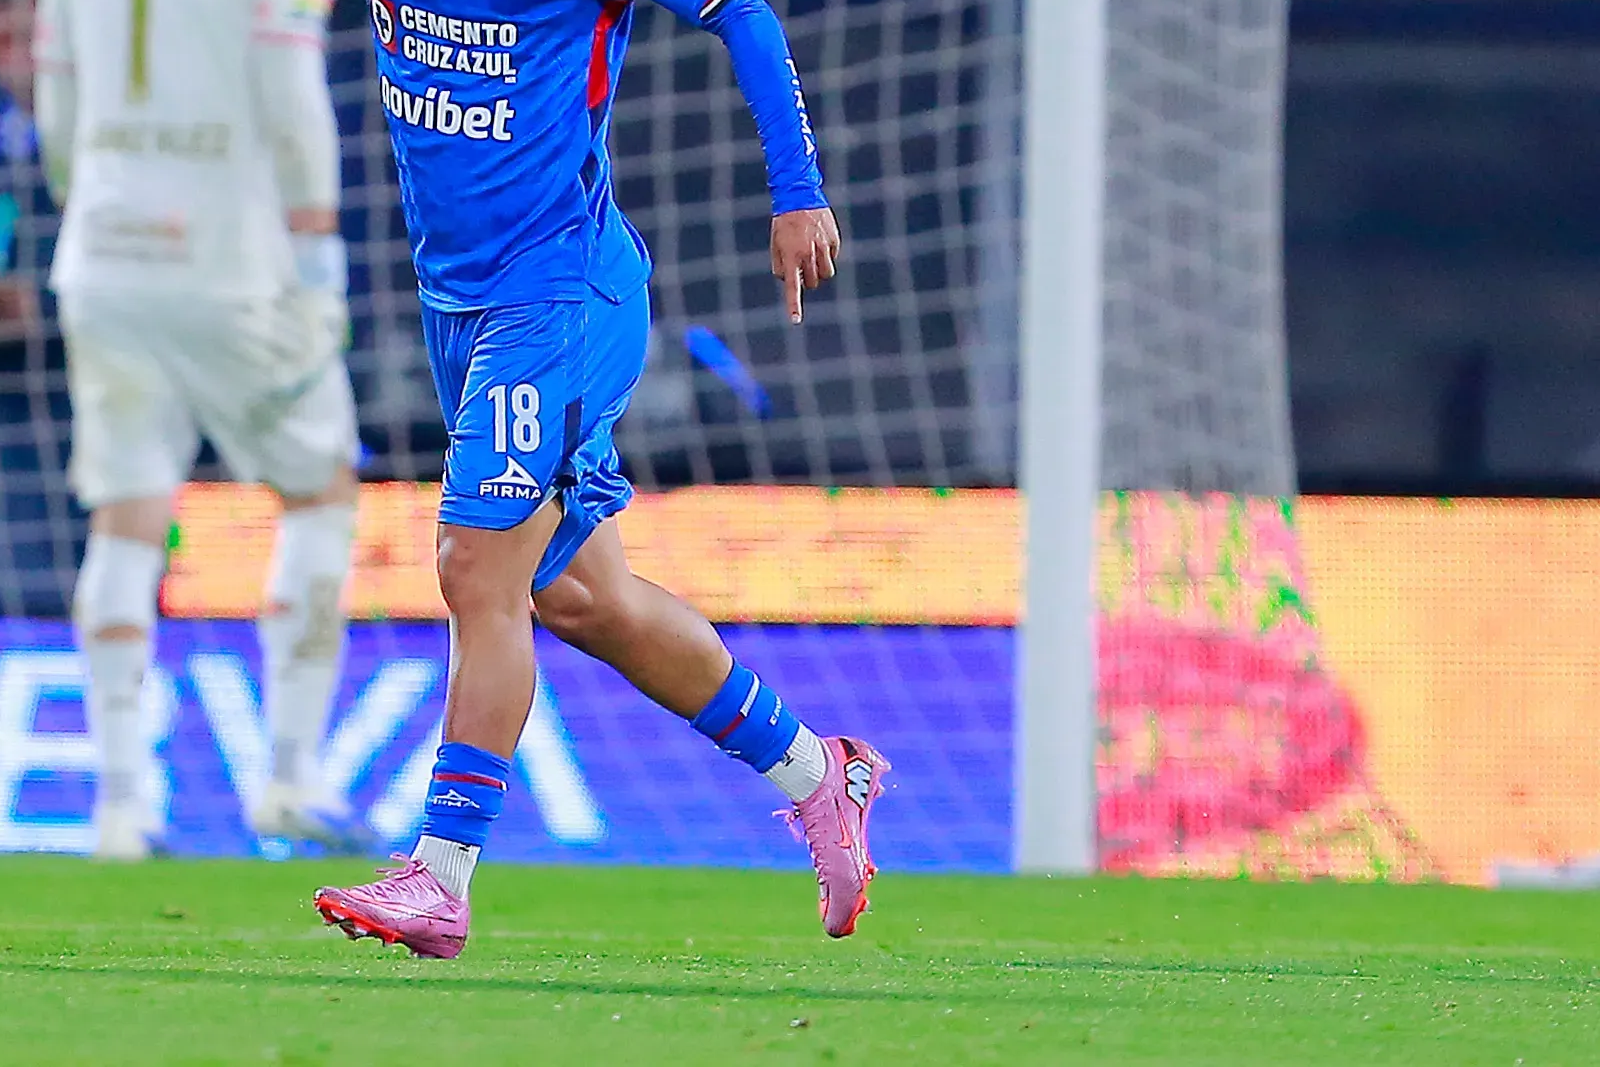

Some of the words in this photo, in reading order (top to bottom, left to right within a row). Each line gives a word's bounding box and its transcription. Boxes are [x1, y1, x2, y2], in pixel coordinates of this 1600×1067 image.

[399, 4, 517, 47] CEMENTO
[402, 34, 454, 70] CRUZ
[455, 48, 517, 76] AZUL
[380, 74, 515, 141] novibet
[487, 383, 541, 453] 18
[479, 483, 542, 500] PIRMA
